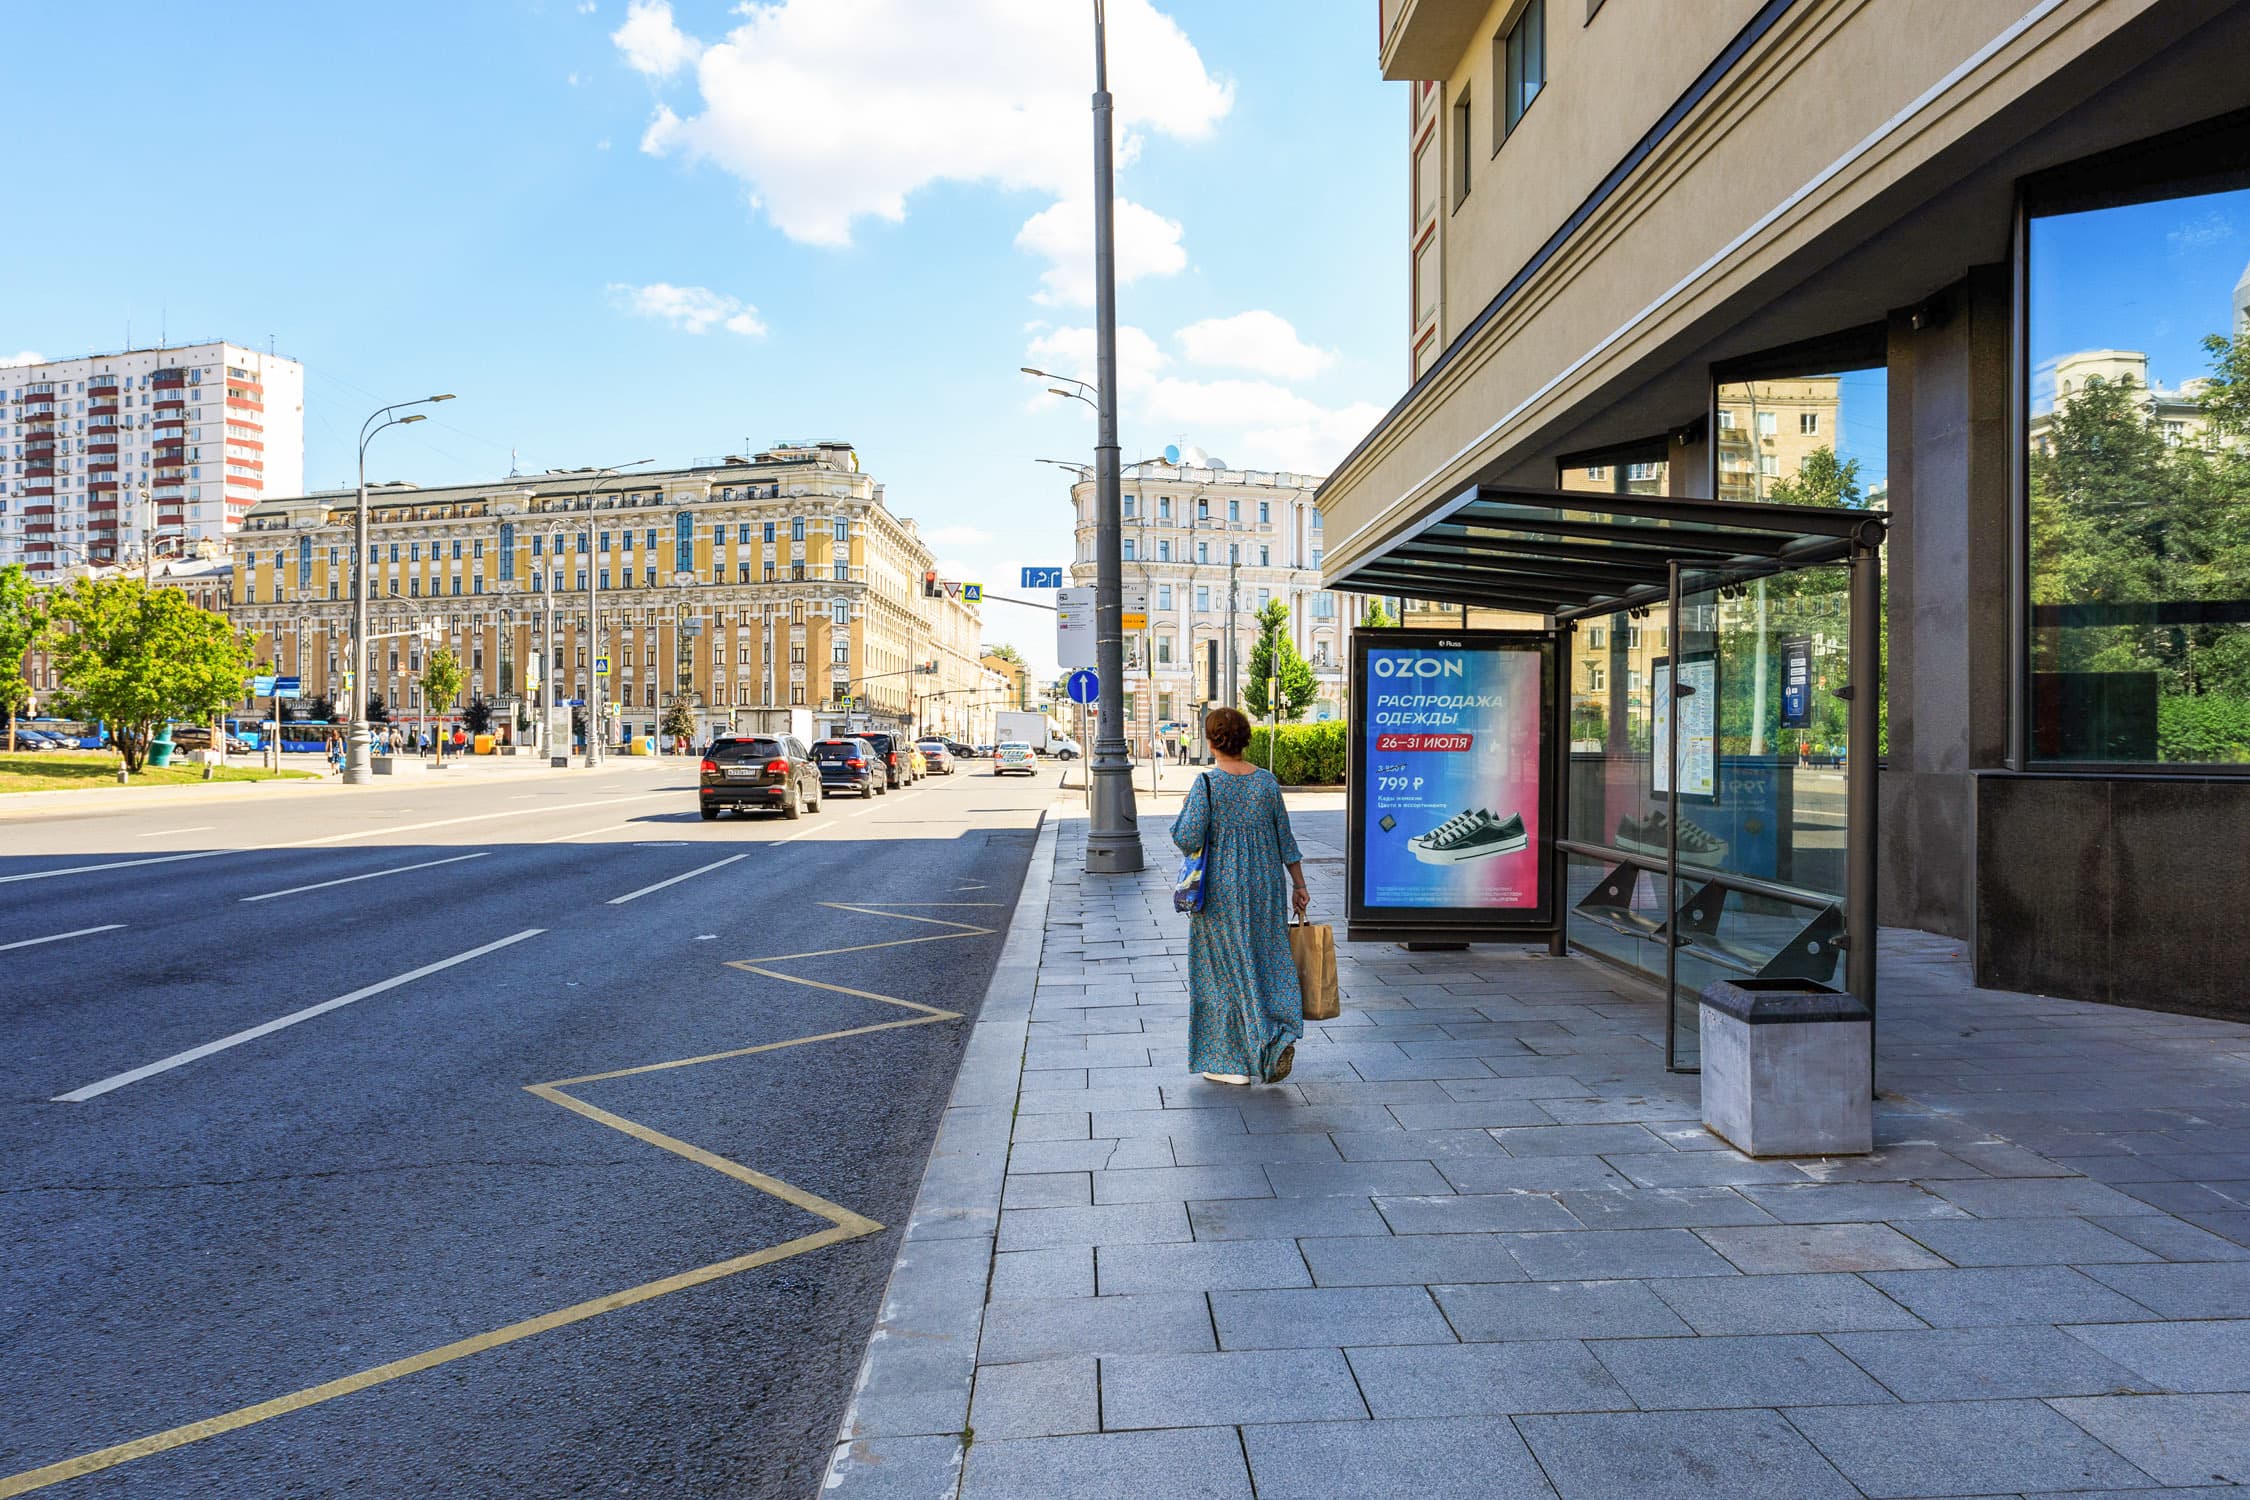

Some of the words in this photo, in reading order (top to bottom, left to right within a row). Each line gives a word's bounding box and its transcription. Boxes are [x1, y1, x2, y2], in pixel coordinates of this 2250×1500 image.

[1446, 640, 1462, 648] Russ
[1375, 658, 1463, 678] OZON
[1377, 694, 1504, 709] РАСПРОДАЖА
[1376, 711, 1458, 726] ОДЕЖДЫ
[1423, 737, 1468, 749] ИЮЛЯ
[1378, 776, 1409, 791] 799
